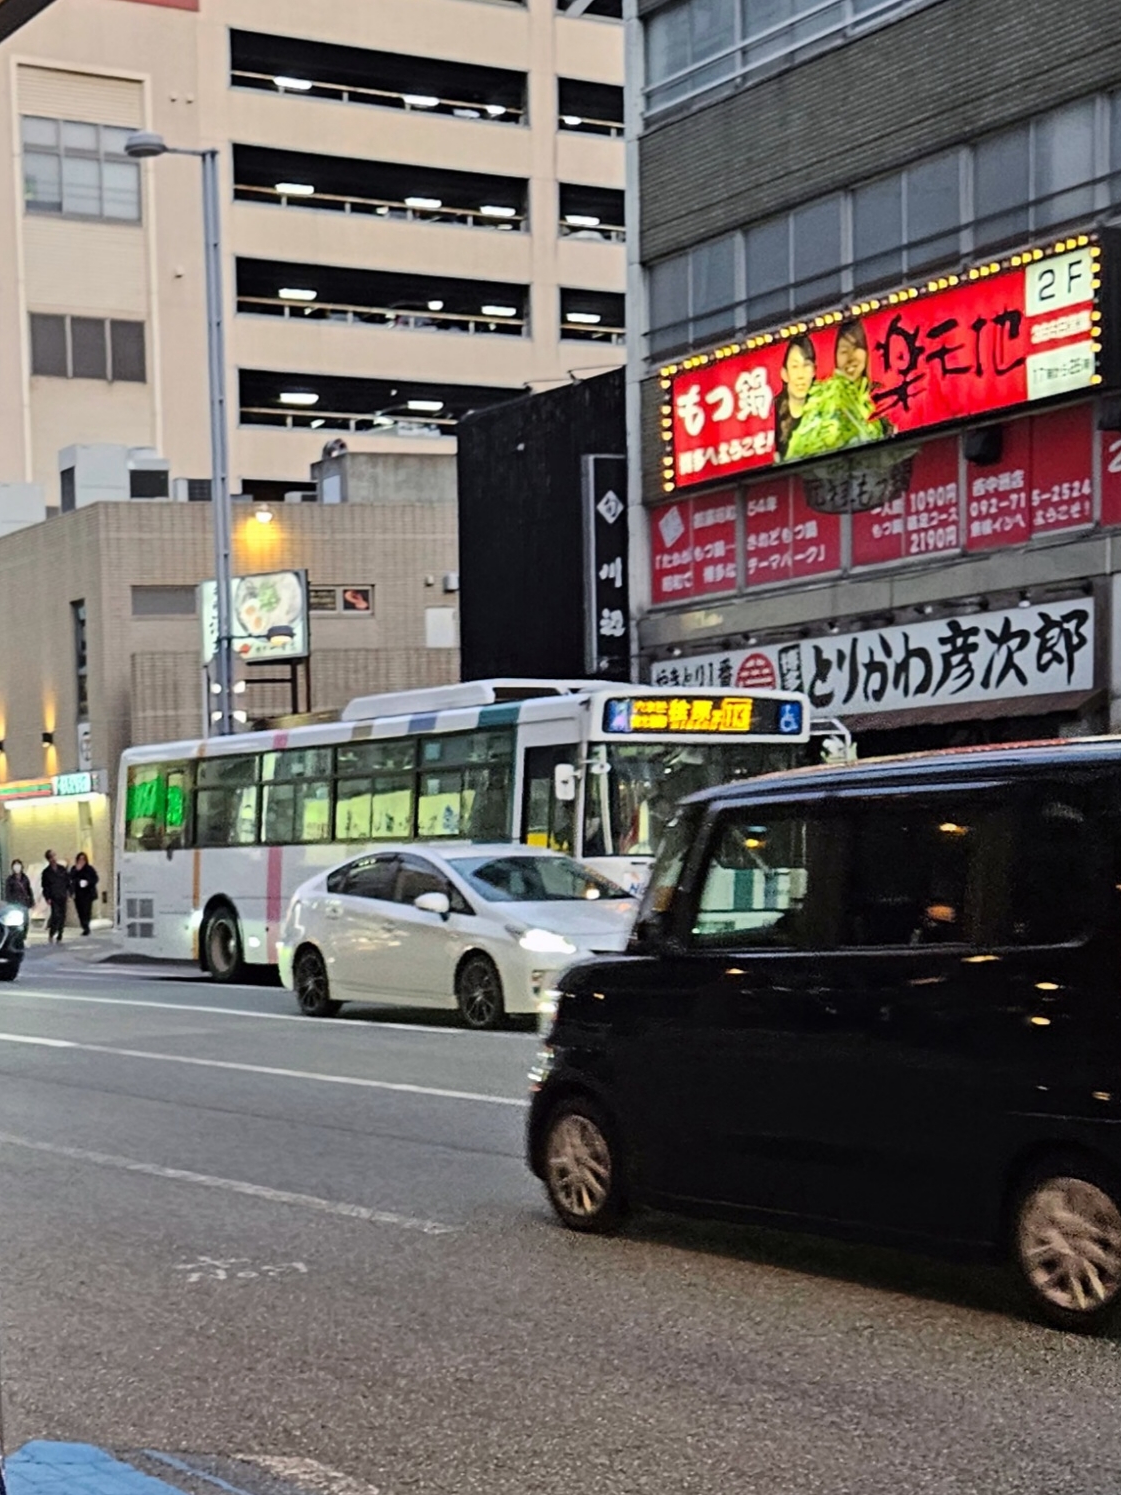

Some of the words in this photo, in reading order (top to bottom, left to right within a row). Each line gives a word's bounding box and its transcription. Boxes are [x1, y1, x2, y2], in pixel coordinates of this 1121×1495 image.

[676, 366, 774, 437] もつ鍋
[909, 482, 957, 513] 1090円
[909, 525, 957, 554] 2190円
[809, 609, 1090, 709] とりかわ彦次郎
